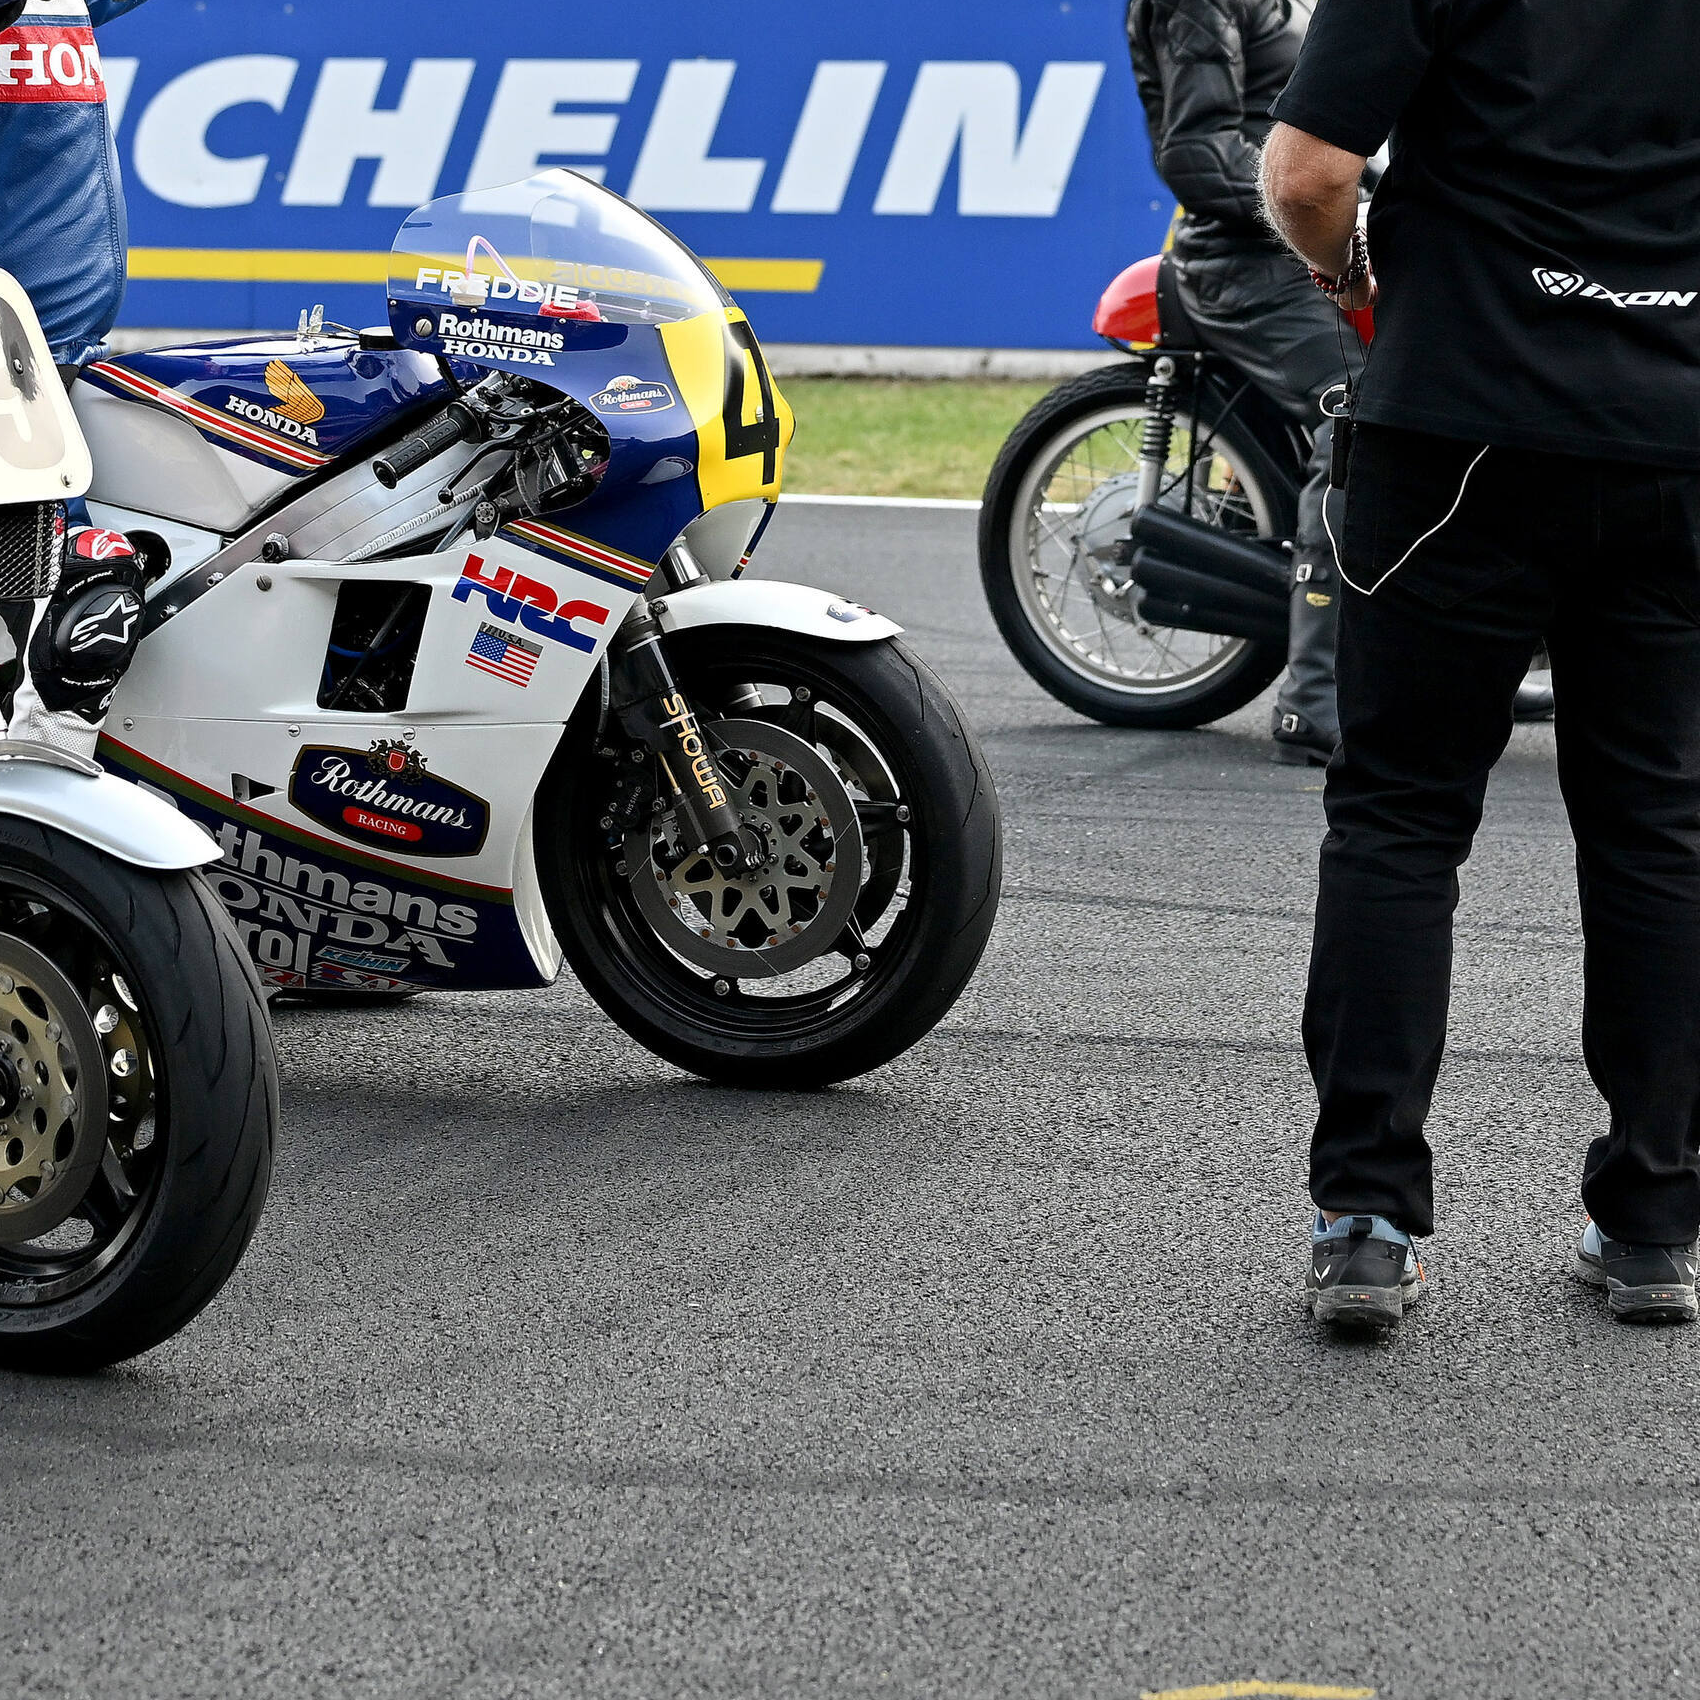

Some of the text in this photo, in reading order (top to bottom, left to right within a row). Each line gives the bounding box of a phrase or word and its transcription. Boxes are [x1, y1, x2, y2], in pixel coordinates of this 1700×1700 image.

[415, 267, 580, 311] FREDDIE
[438, 312, 565, 351] Rothmans
[442, 338, 557, 368] HONDA
[224, 393, 321, 447] HONDA
[598, 387, 666, 407] Rothmans
[722, 319, 781, 487] 4
[450, 551, 611, 656] HRC
[660, 692, 728, 811] SHOWA
[310, 755, 473, 831] Rothmans
[357, 813, 408, 837] RACING
[184, 810, 478, 937] thmans
[202, 872, 455, 969] ONDA
